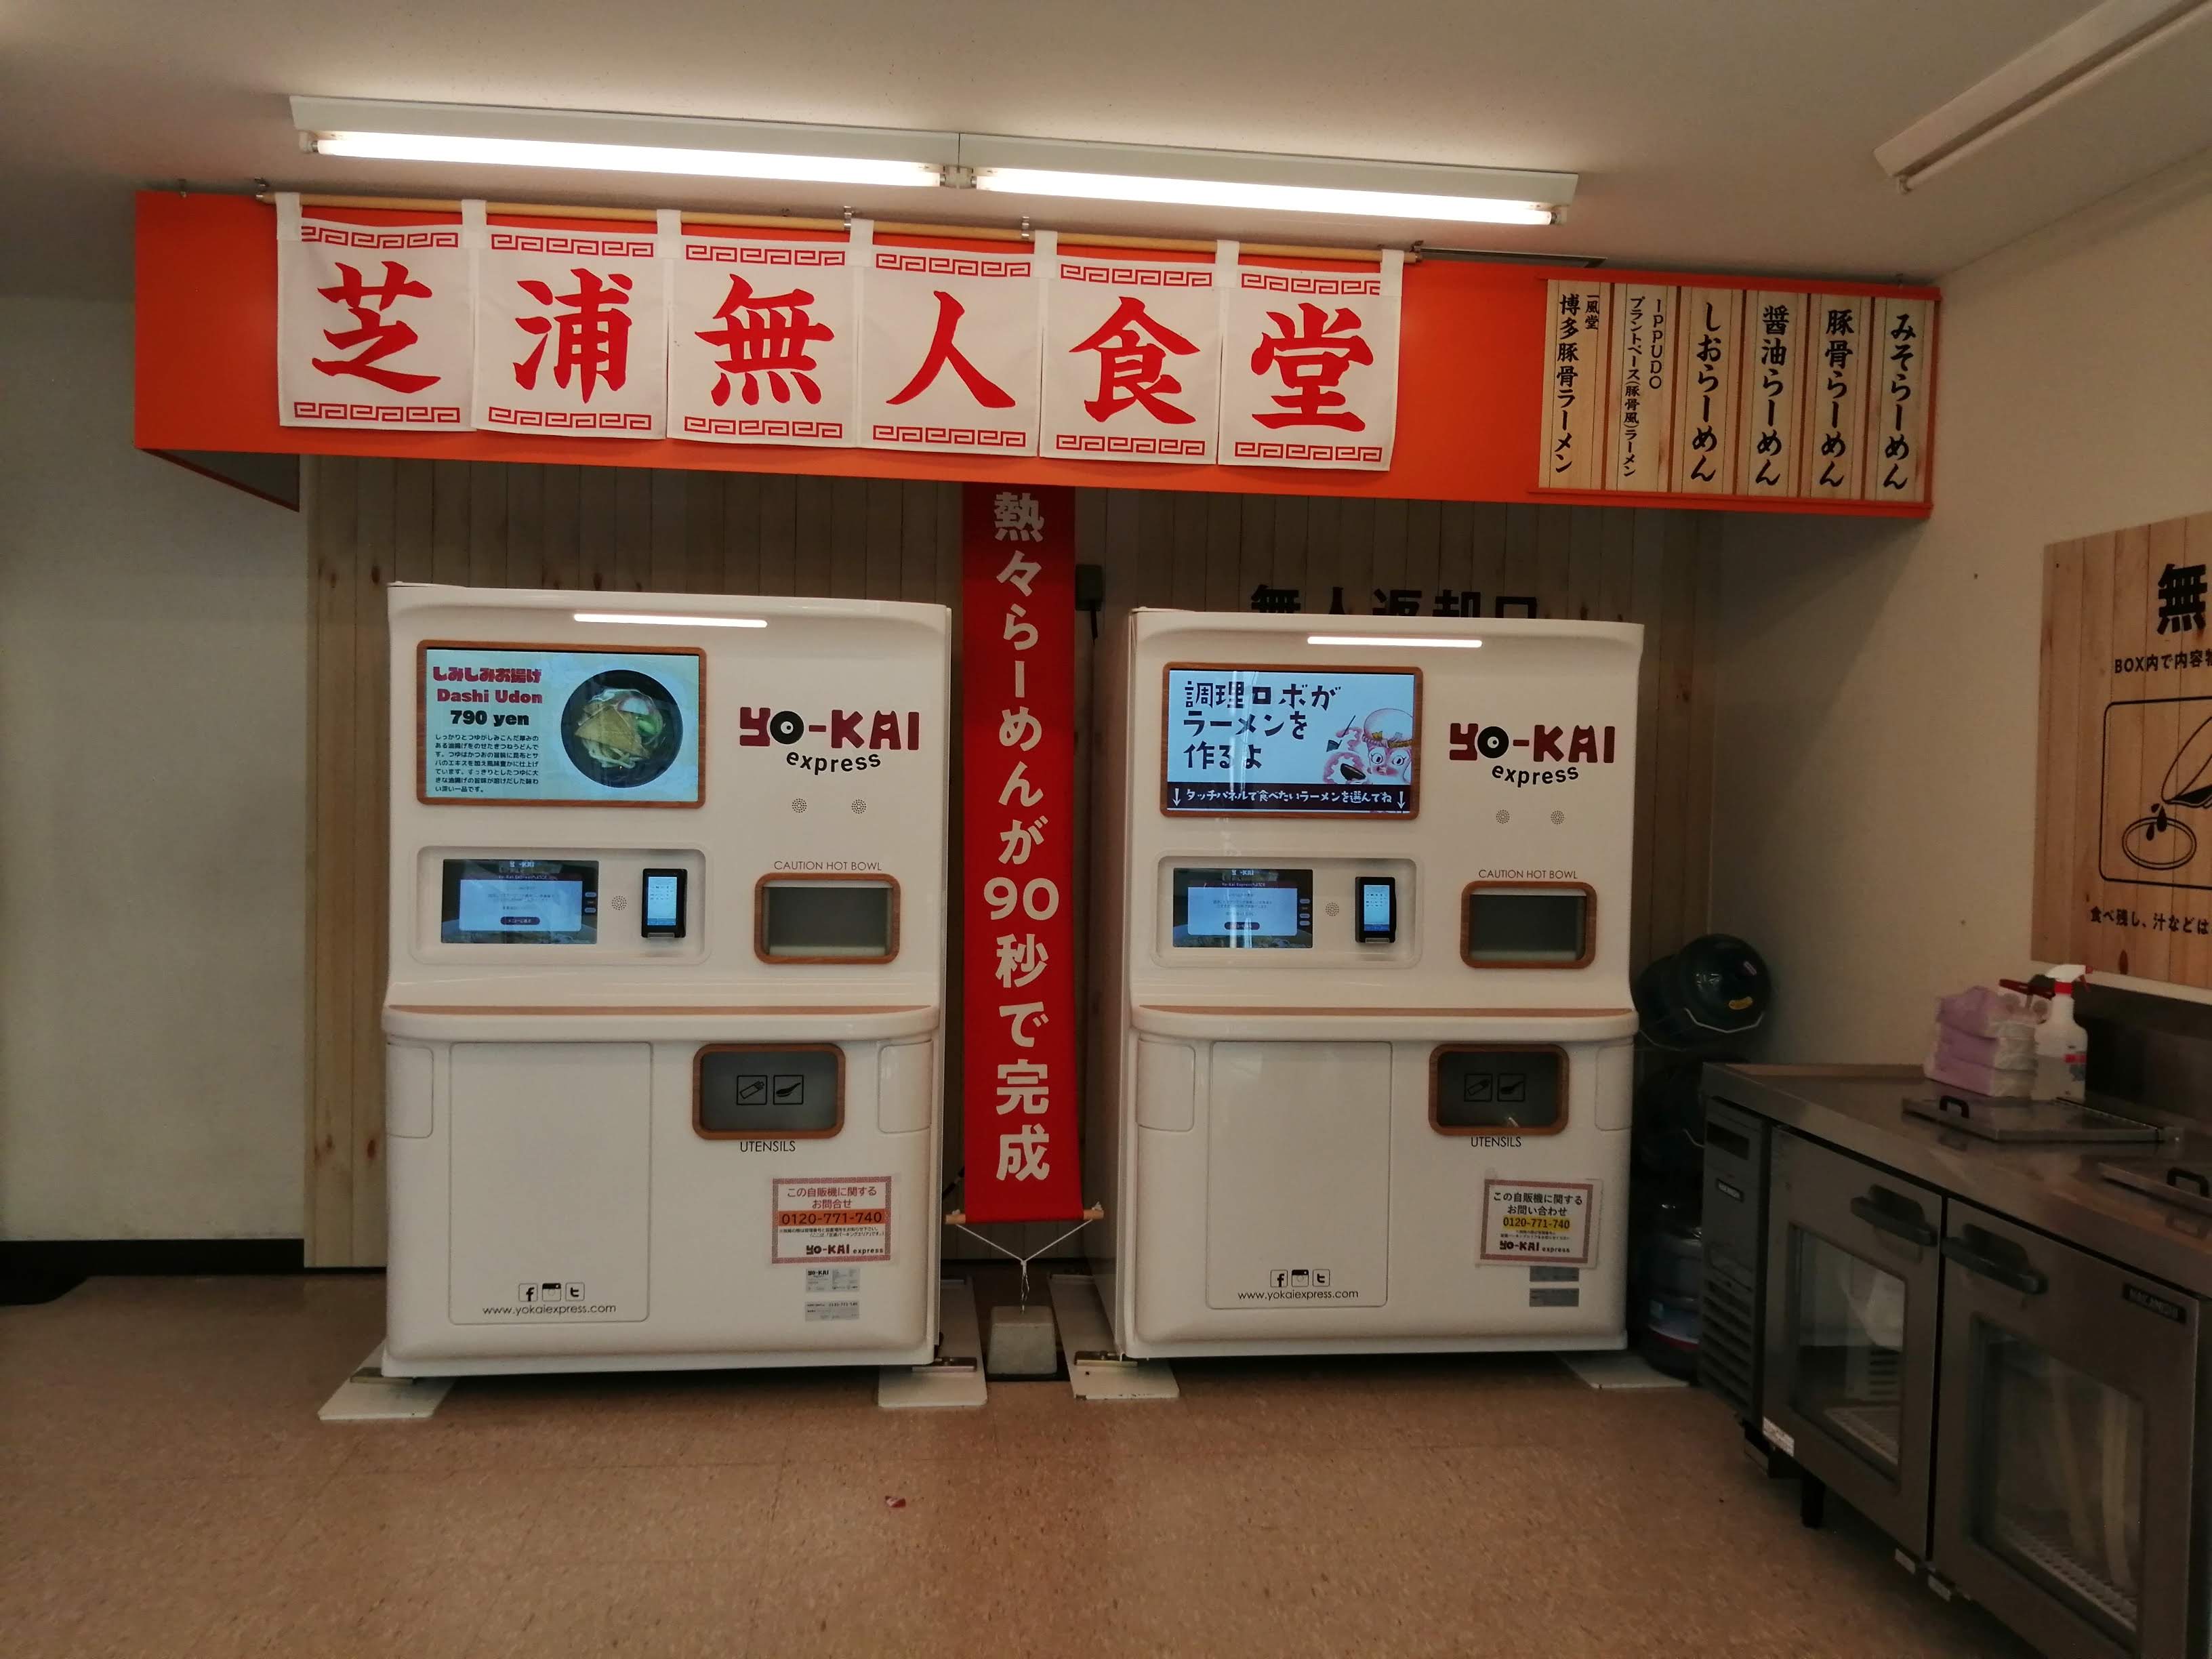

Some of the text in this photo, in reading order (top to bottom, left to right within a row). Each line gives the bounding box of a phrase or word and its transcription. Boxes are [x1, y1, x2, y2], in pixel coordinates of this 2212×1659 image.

[1584, 293, 1600, 331] 一風堂
[311, 260, 1374, 432] 芝浦無人食堂
[1649, 299, 1664, 390] IPPUDO
[1554, 293, 1581, 473] 博多豚骨ラーメン
[1690, 302, 1722, 483] しおらーめん
[1755, 304, 1790, 486] 醤油らーめん
[1819, 308, 1855, 488] 豚骨らーめん
[1883, 313, 1917, 490] みそらーめん
[2157, 563, 2208, 636] 無
[432, 666, 543, 684] しみしみお揚げ
[436, 688, 543, 704] Dashi Udon
[1184, 680, 1342, 712] 調理ロボが
[450, 710, 529, 727] 790 yen
[1183, 710, 1309, 741] ラーメンを
[786, 752, 882, 776] express
[1183, 740, 1263, 770] 作るよ
[1492, 765, 1579, 787] express
[1186, 788, 1393, 804] タッチパネルで食べたいラーメンを選んでね
[983, 491, 1059, 1182] 熱々らーめんが90秒で完成
[773, 861, 882, 871] CAUTION HOT BOWL
[1478, 869, 1578, 880] CAUTION HOT BOWL
[739, 1140, 796, 1153] UTENSILS
[1470, 1136, 1522, 1147] UTENSILS
[786, 1186, 878, 1197] この自販機に関する
[1493, 1192, 1583, 1206] この自販機に関する
[812, 1199, 852, 1210] お問合せ
[1507, 1205, 1568, 1217] お問い合わせ
[781, 1211, 882, 1225] 0120-771-740
[1502, 1216, 1571, 1229] 0120-771-740
[1237, 1290, 1359, 1301] www.yokaiexpress.com
[482, 1305, 617, 1316] www.yokaiexpress.com
